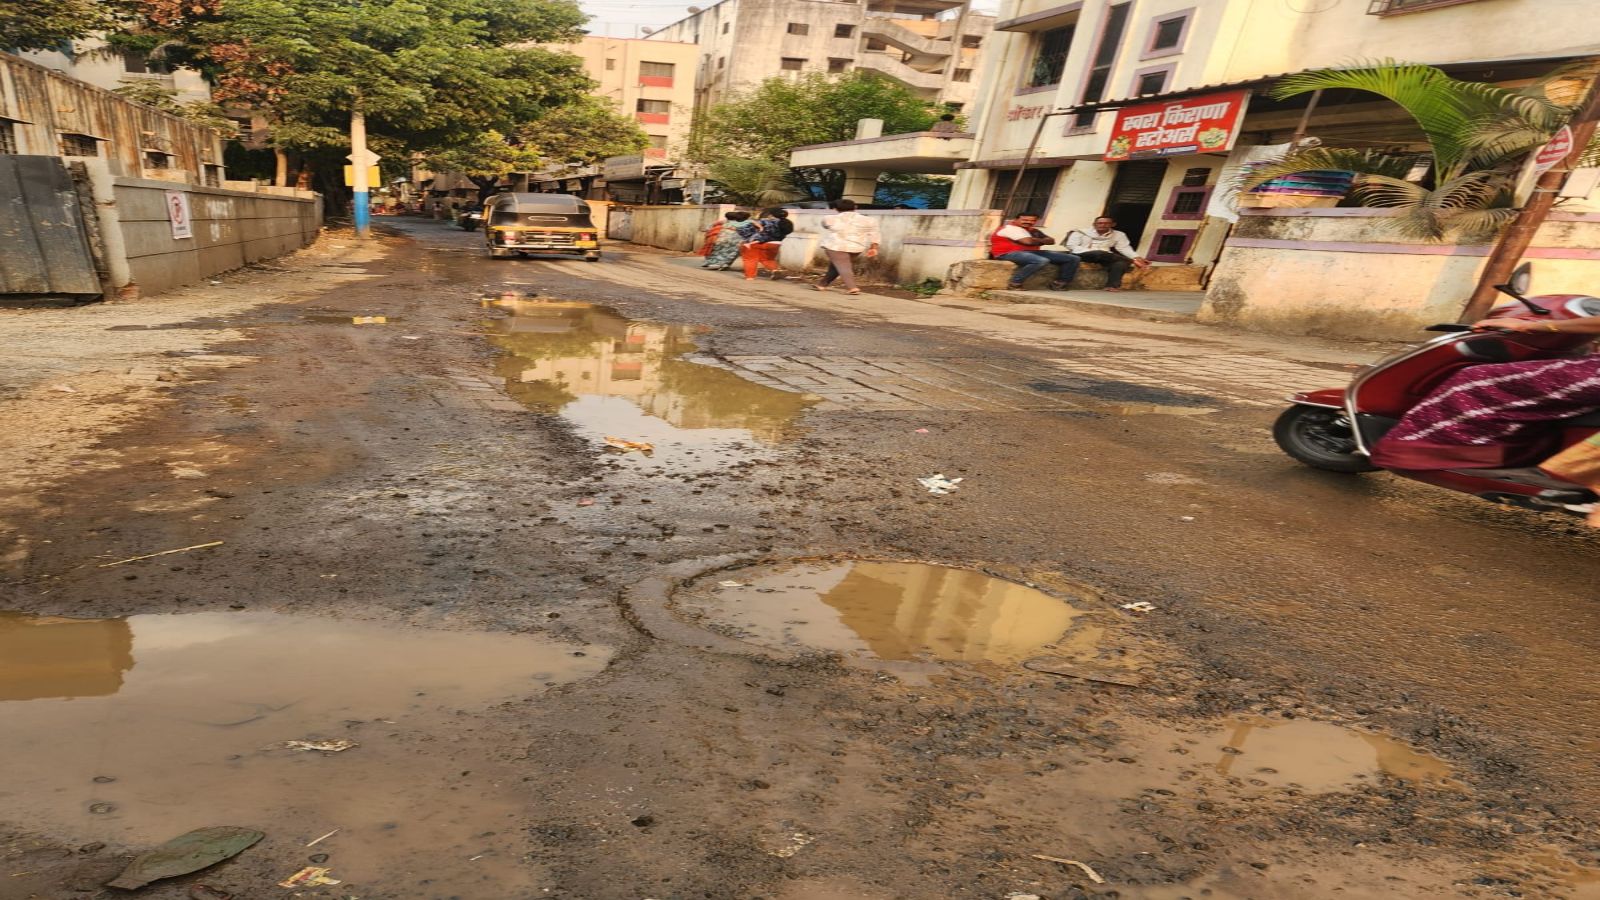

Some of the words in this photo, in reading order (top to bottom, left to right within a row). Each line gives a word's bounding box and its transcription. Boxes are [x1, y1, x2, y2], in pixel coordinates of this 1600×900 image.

[1121, 112, 1162, 132] स्वरा
[1162, 101, 1231, 127] किराणा
[1135, 122, 1201, 148] स्टोअर्स
